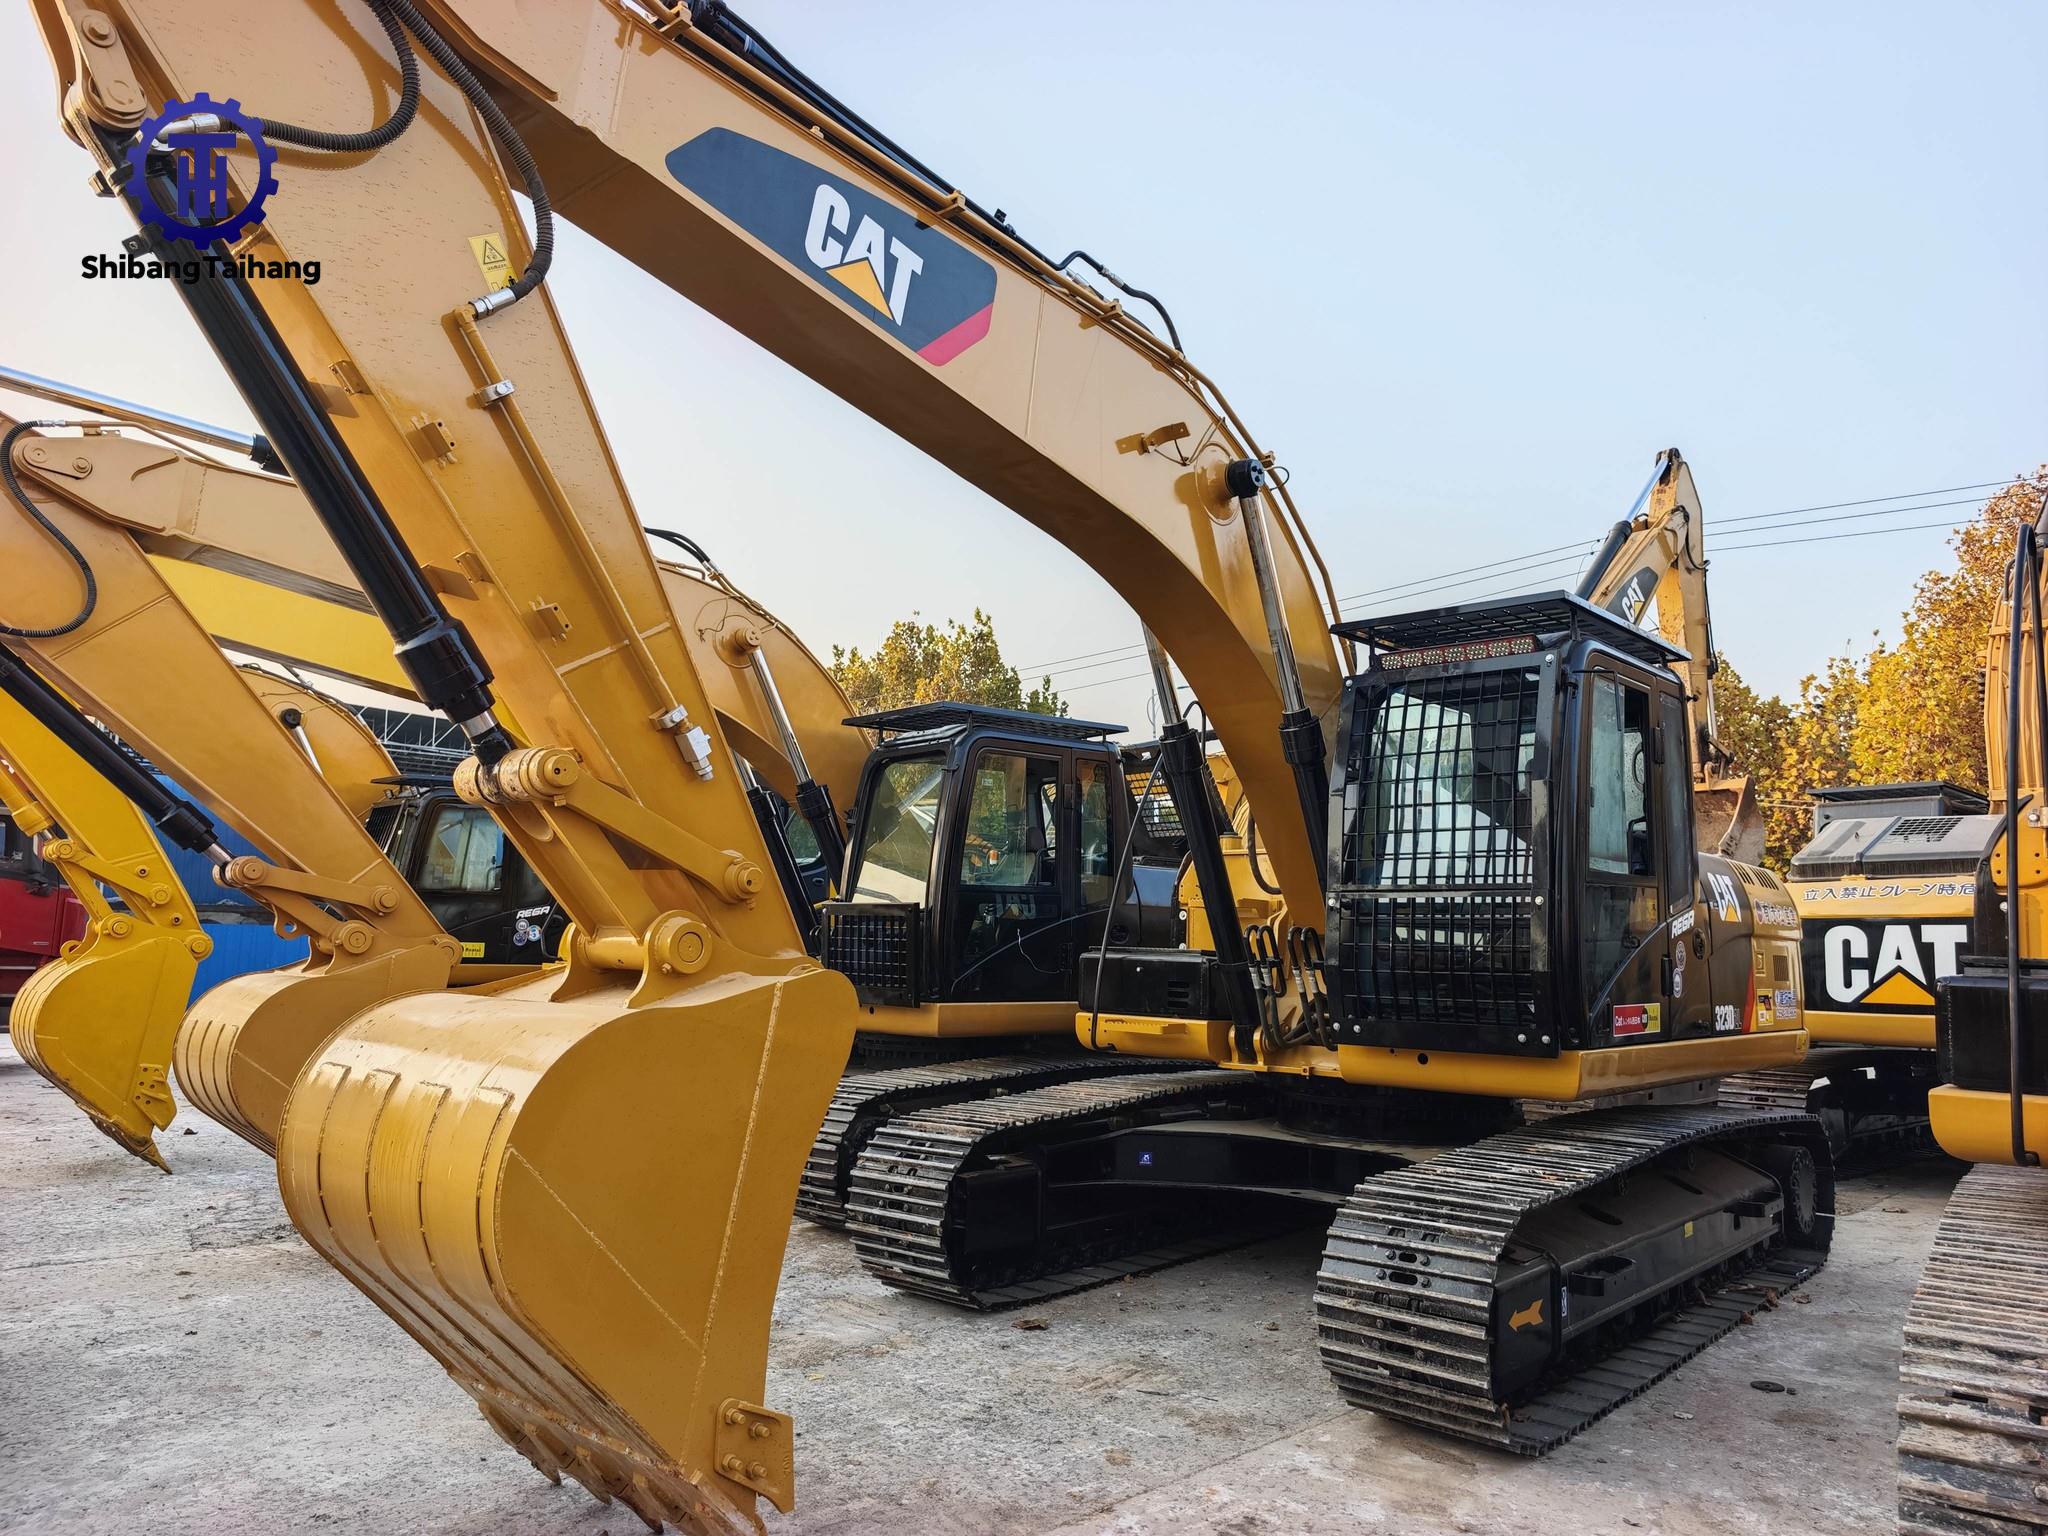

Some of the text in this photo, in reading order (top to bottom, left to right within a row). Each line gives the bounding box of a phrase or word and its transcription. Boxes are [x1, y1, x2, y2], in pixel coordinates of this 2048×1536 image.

[805, 184, 924, 326] CAT
[1622, 577, 1645, 623] CAT
[516, 906, 551, 919] REGA
[1707, 872, 1742, 922] CAT
[1824, 925, 1967, 1004] CAT
